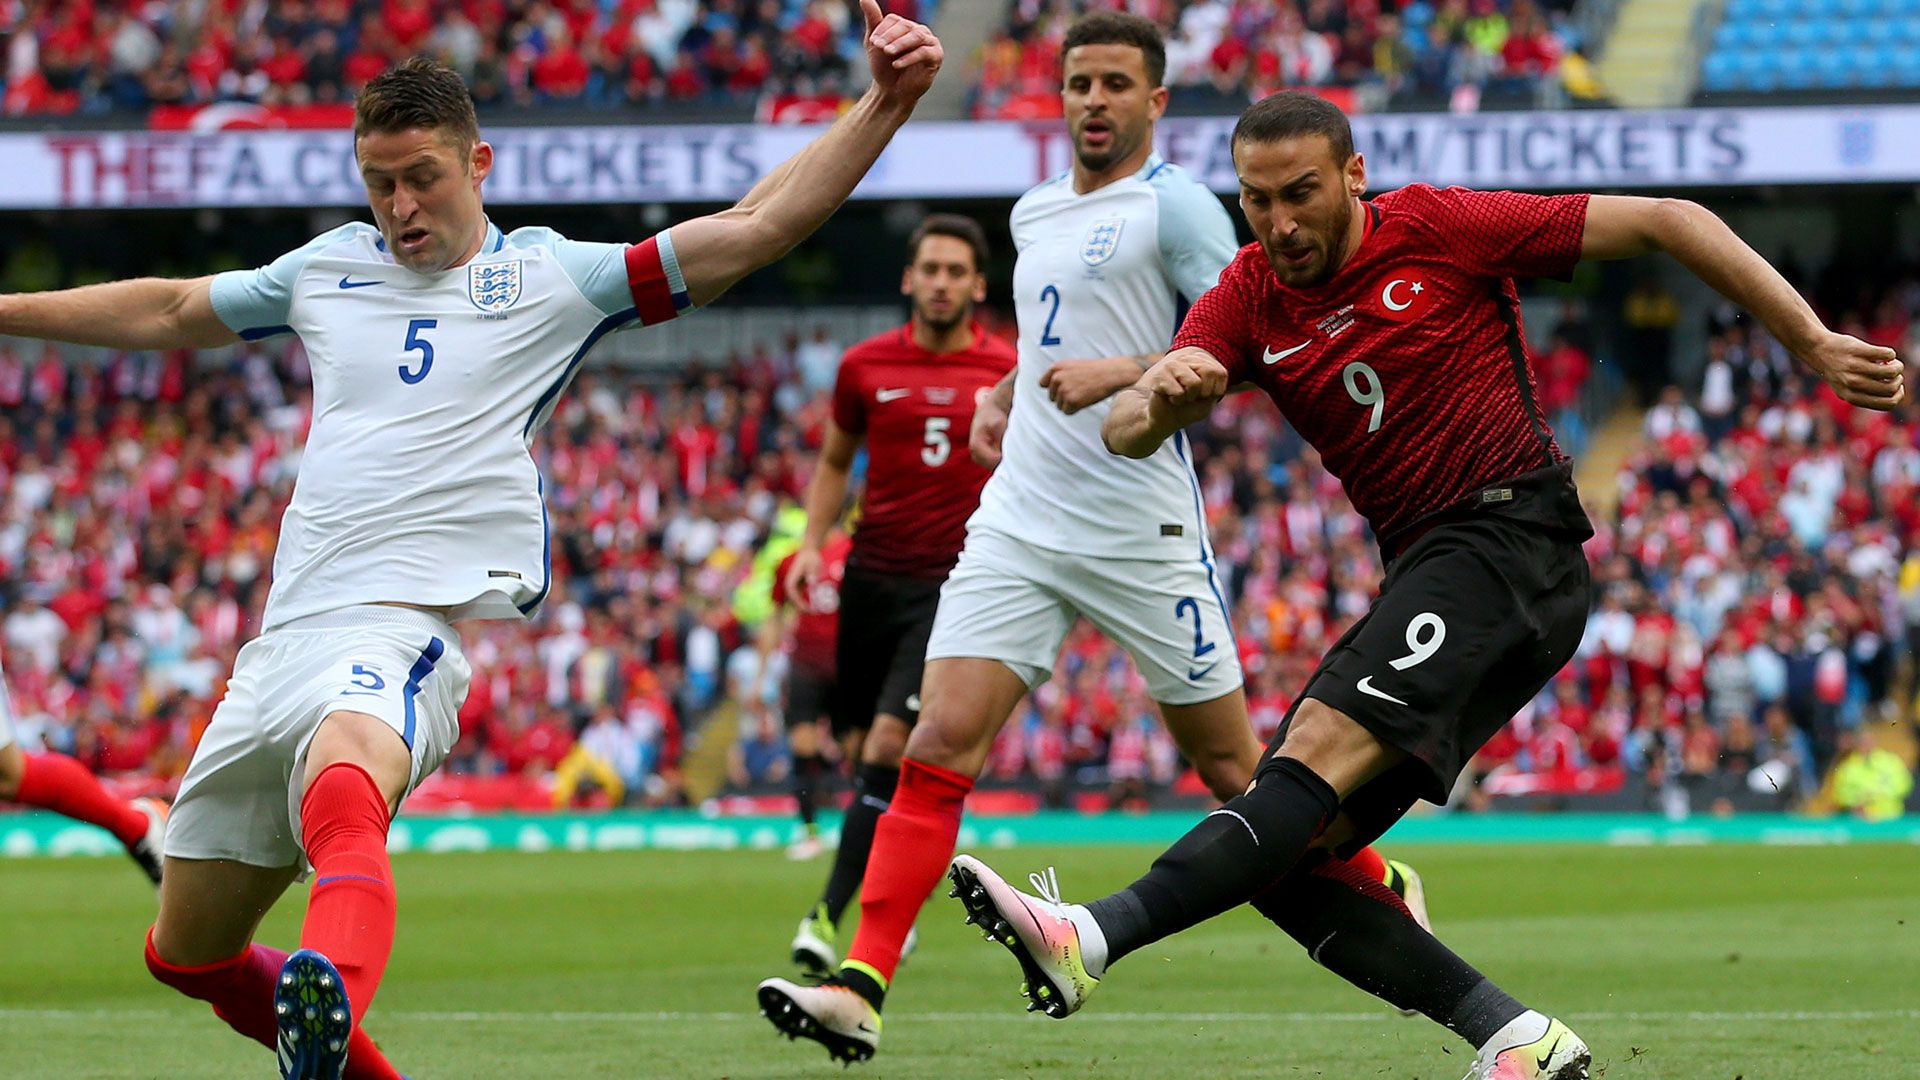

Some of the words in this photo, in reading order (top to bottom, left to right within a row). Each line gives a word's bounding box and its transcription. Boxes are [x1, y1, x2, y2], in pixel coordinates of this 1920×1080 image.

[1040, 285, 1060, 346] 2
[398, 319, 437, 385] 5
[1342, 361, 1385, 433] 9
[921, 416, 951, 468] 5
[1176, 596, 1215, 657] 2
[1388, 611, 1447, 671] 9
[350, 664, 386, 690] 5
